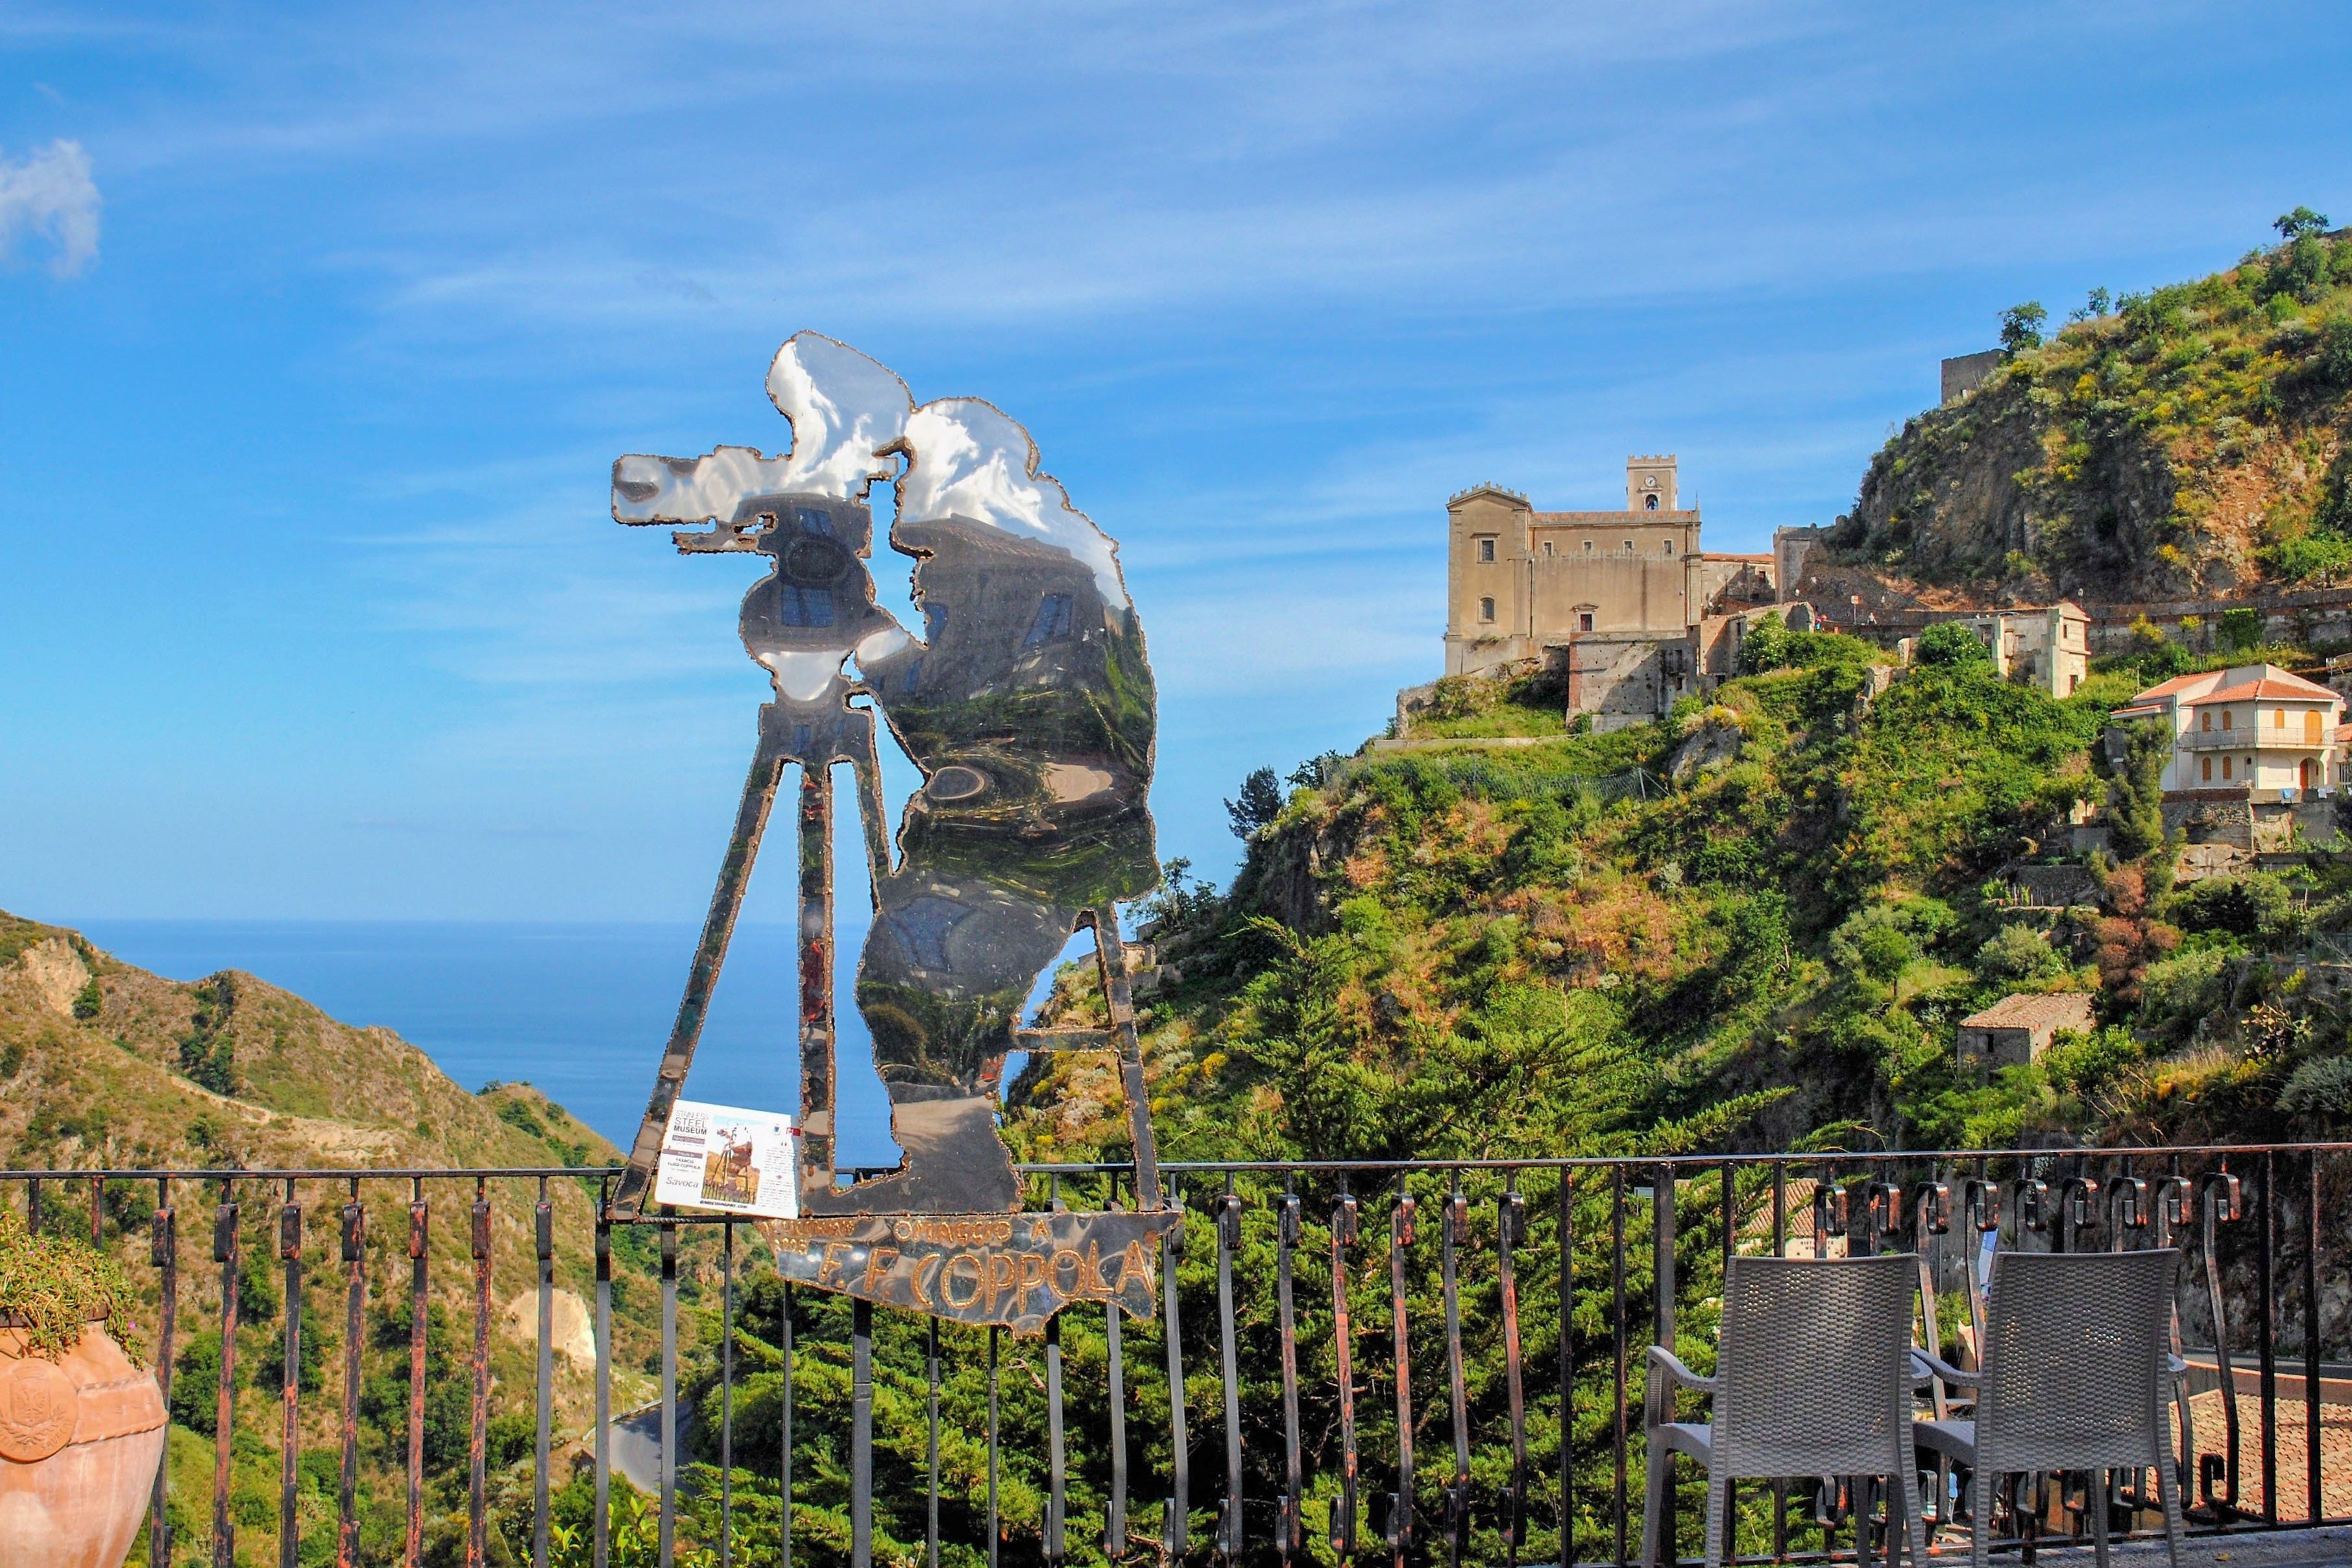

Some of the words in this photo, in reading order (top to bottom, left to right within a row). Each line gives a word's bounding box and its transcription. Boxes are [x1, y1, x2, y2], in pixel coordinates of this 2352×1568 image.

[675, 1117, 706, 1128] STEEL
[673, 1125, 707, 1135] MUSEUM
[666, 1176, 699, 1188] Savoca
[893, 1219, 1012, 1246] OMAGGIO
[1031, 1218, 1052, 1244] A
[911, 1239, 1156, 1314] COPPOLA
